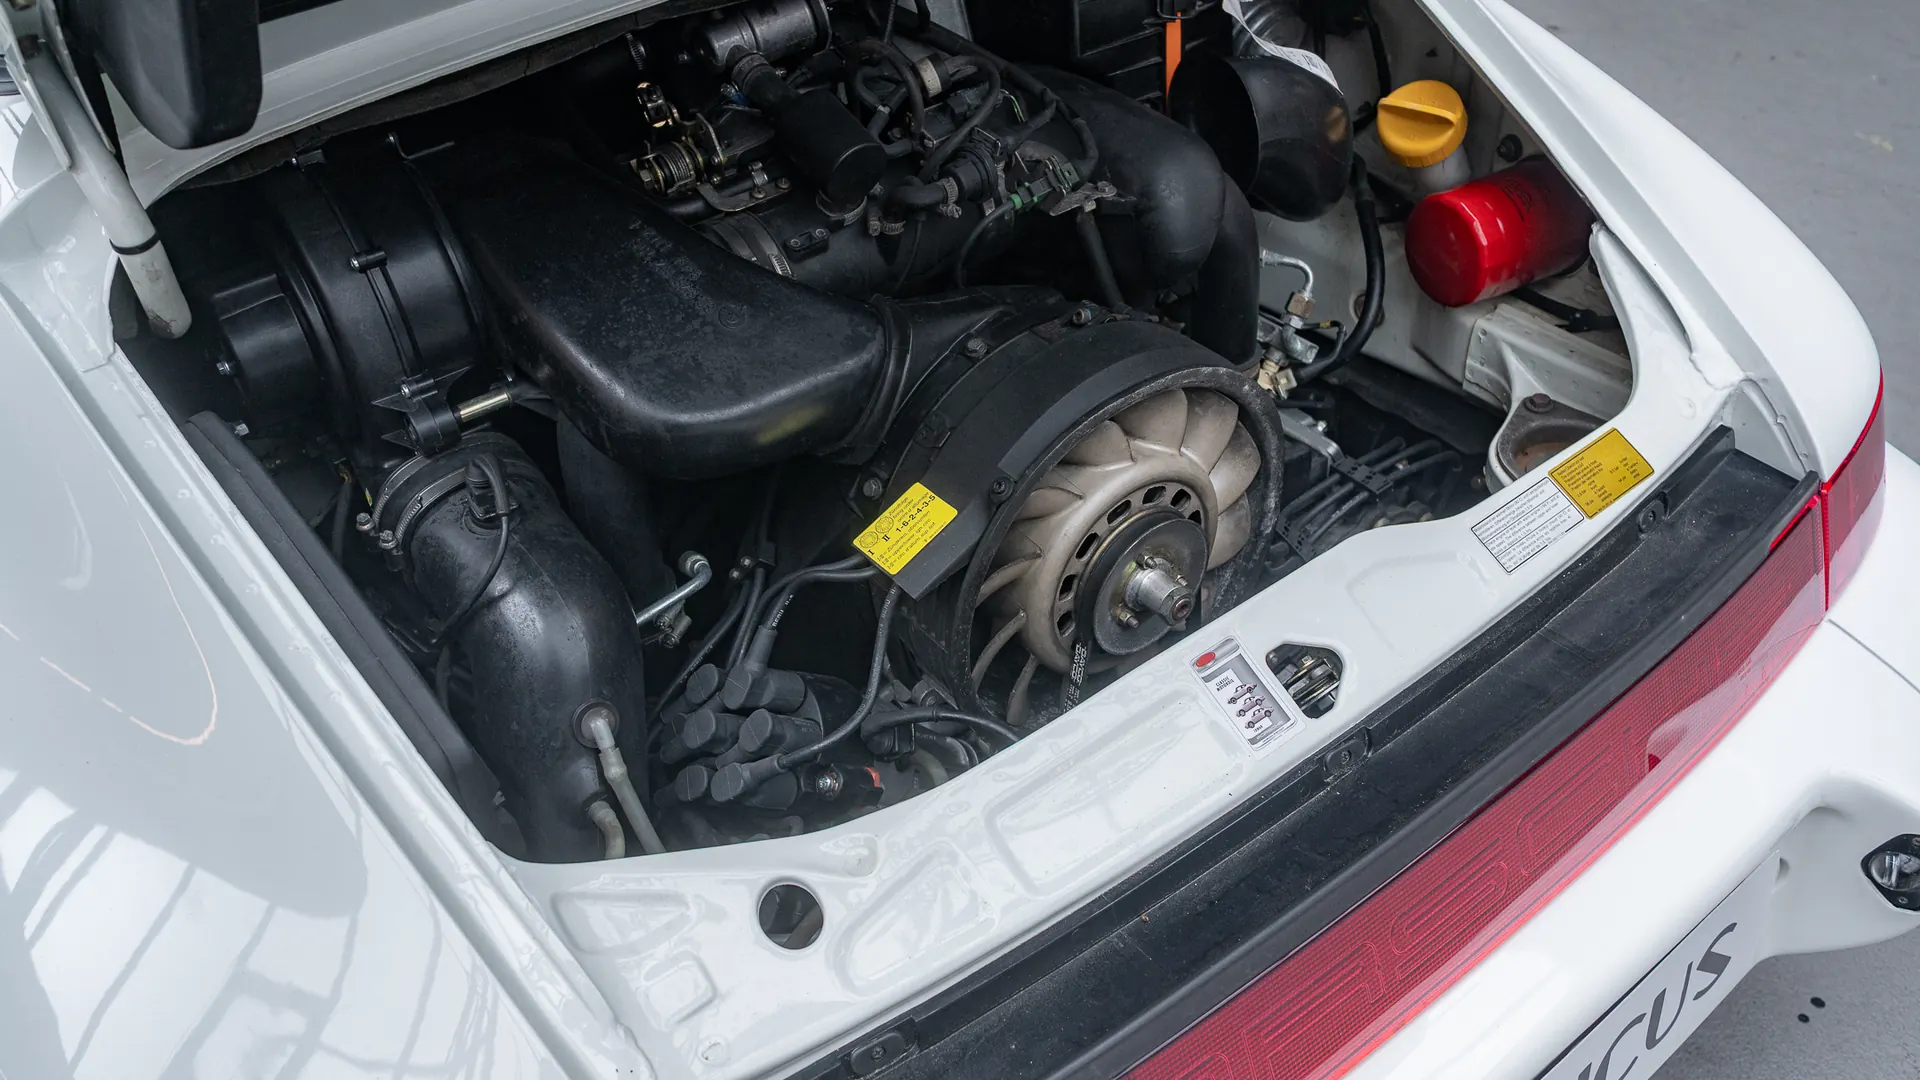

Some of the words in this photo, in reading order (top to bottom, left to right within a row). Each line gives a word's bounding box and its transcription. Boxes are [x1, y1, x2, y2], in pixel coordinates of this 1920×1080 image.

[894, 494, 936, 533] 1-6-2-4-3-5
[1070, 644, 1082, 682] DAYCO
[1076, 648, 1087, 686] DAYCO
[1578, 922, 1738, 1080] CUS
